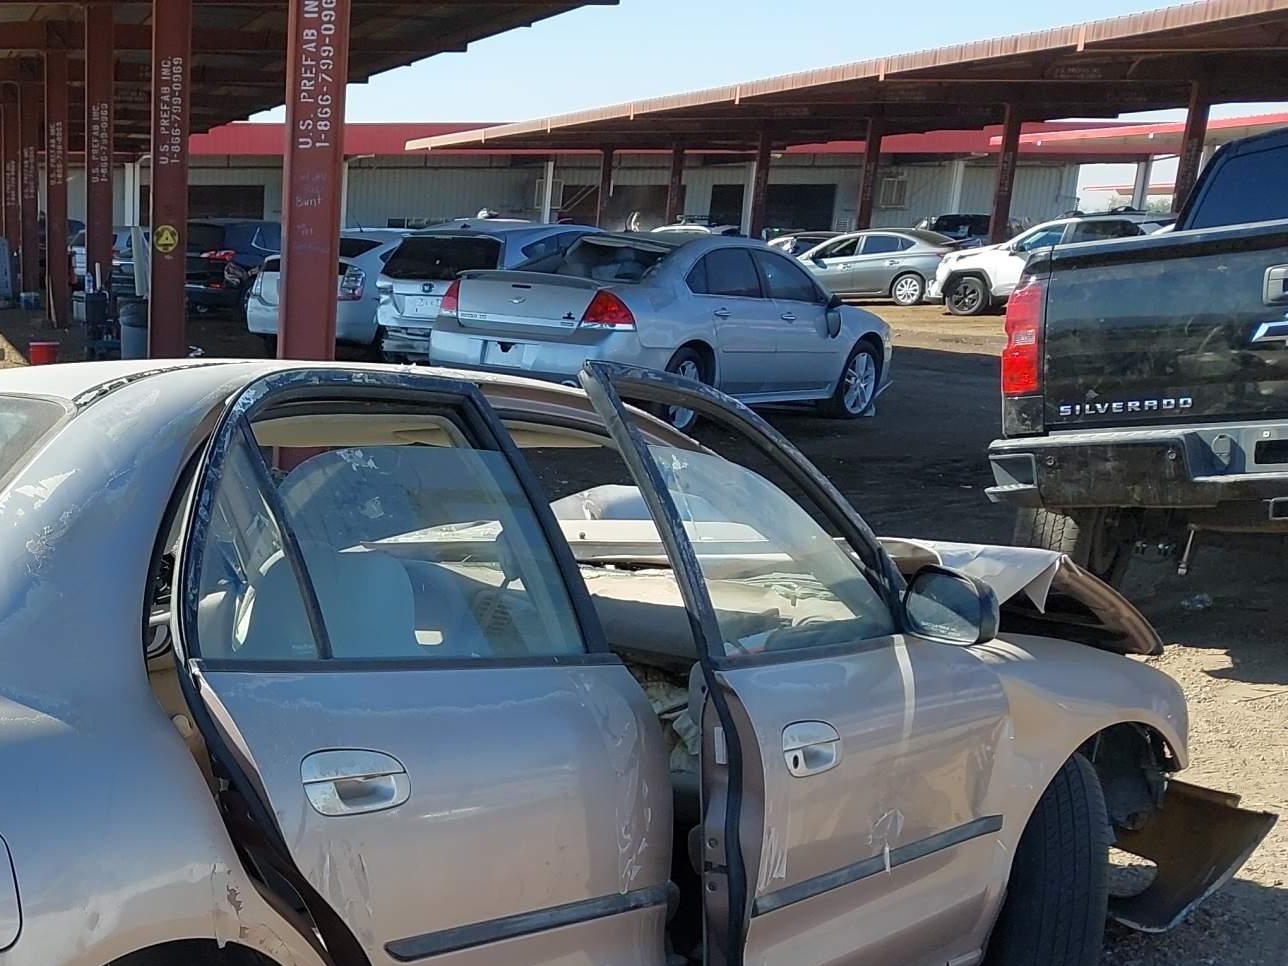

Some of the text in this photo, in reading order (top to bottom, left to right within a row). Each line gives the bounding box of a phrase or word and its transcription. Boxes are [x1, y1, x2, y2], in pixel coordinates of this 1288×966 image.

[300, 28, 318, 103] PREFAB
[159, 56, 172, 165] U.S. PREFAB INC.
[170, 57, 183, 164] 1-866-799-0969
[298, 113, 314, 150] U.S.
[1059, 397, 1192, 416] SILVERADO
